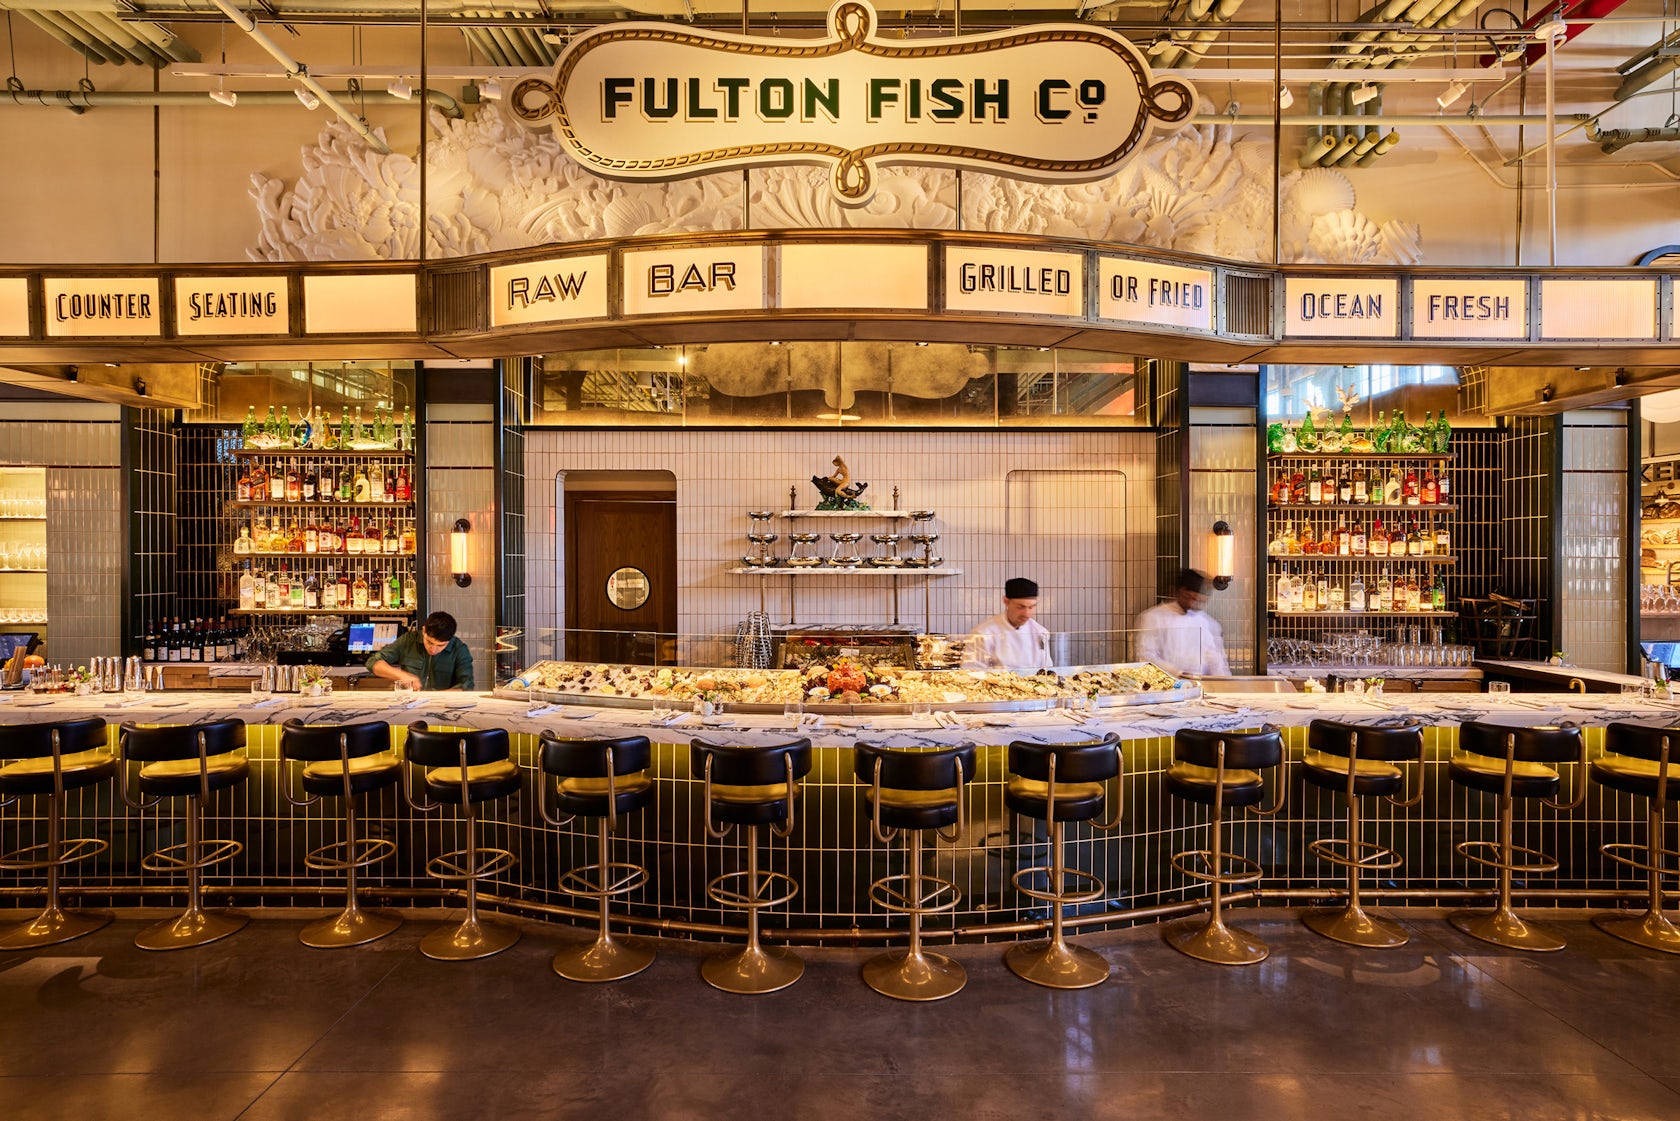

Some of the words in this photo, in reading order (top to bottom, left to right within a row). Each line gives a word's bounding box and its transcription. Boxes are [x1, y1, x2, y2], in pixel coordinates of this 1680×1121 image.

[599, 78, 840, 124] FULTON
[866, 78, 1010, 124] FISH
[56, 292, 152, 323] COUNTER
[189, 291, 278, 322] SEATING
[508, 270, 587, 310] RAW
[647, 262, 737, 298] BAR
[960, 262, 1070, 297] GRILLED
[1110, 274, 1138, 302] OR
[1148, 277, 1203, 310] FRIED
[1300, 292, 1383, 322] OCEAN
[1427, 294, 1510, 323] FRESH
